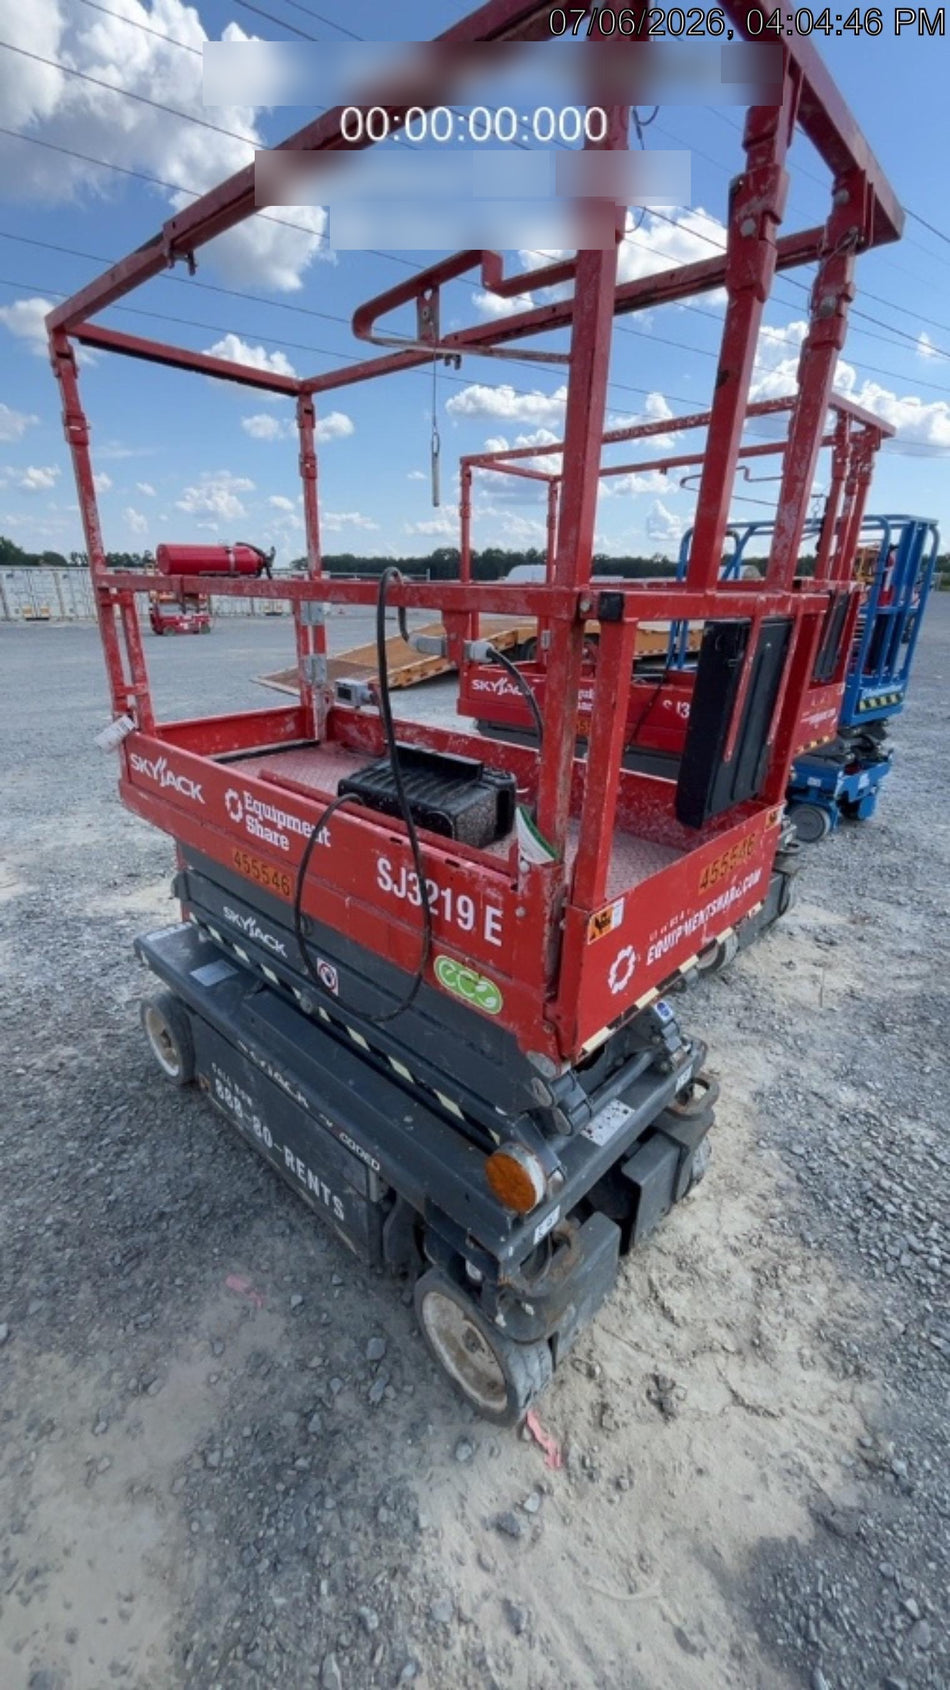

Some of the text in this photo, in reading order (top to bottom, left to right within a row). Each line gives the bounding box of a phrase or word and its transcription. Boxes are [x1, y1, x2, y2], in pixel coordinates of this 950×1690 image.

[471, 677, 536, 696] SKYJAC
[129, 752, 206, 805] SKYJACK
[245, 814, 290, 851] Share
[234, 850, 290, 897] 455546
[376, 857, 503, 947] SJ3219 E
[222, 906, 288, 959] SKYJACK
